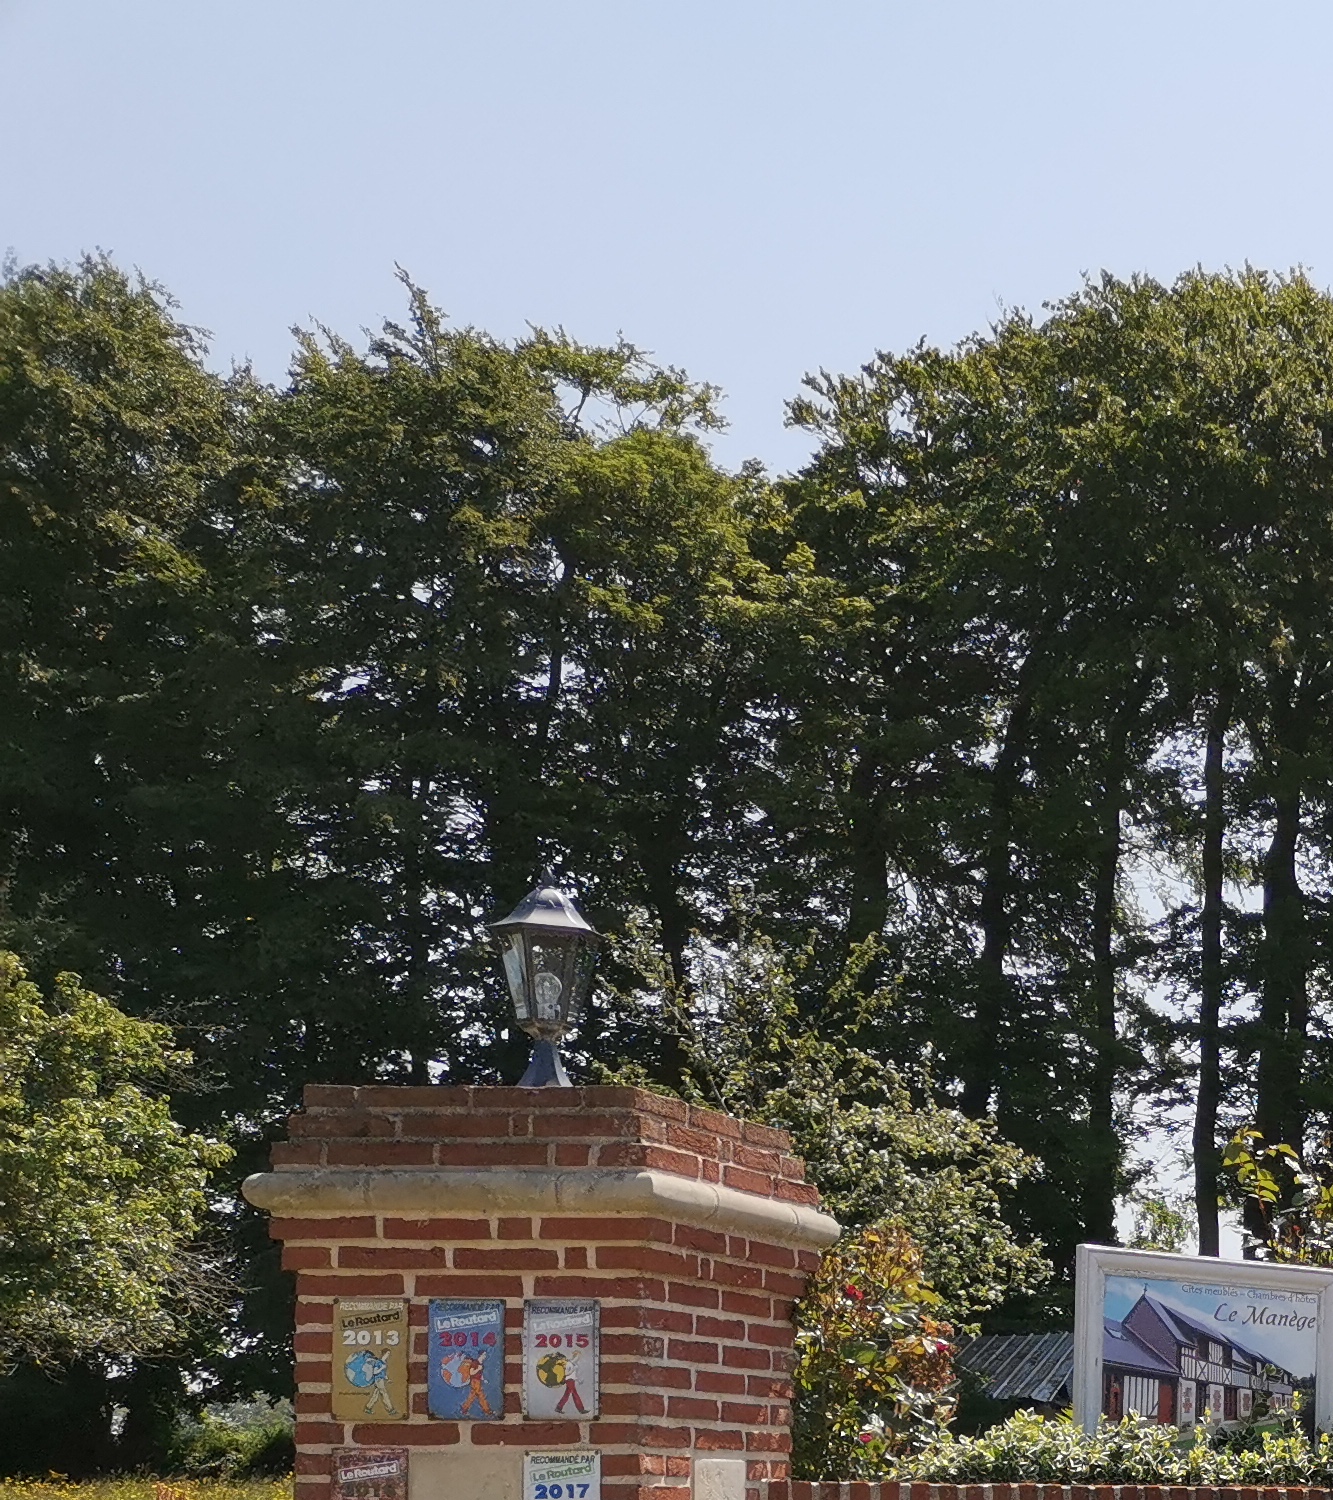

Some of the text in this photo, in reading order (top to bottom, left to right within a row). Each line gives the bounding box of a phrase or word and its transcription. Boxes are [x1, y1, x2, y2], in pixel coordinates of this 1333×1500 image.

[1204, 1286, 1238, 1297] meublés
[1246, 1290, 1286, 1302] Chambres
[1214, 1303, 1317, 1331] Le Manège
[342, 1330, 400, 1346] 2013
[439, 1331, 497, 1347] 2014
[534, 1333, 590, 1349] 2015
[580, 1454, 596, 1464] PAR
[534, 1484, 590, 1500] 2017
